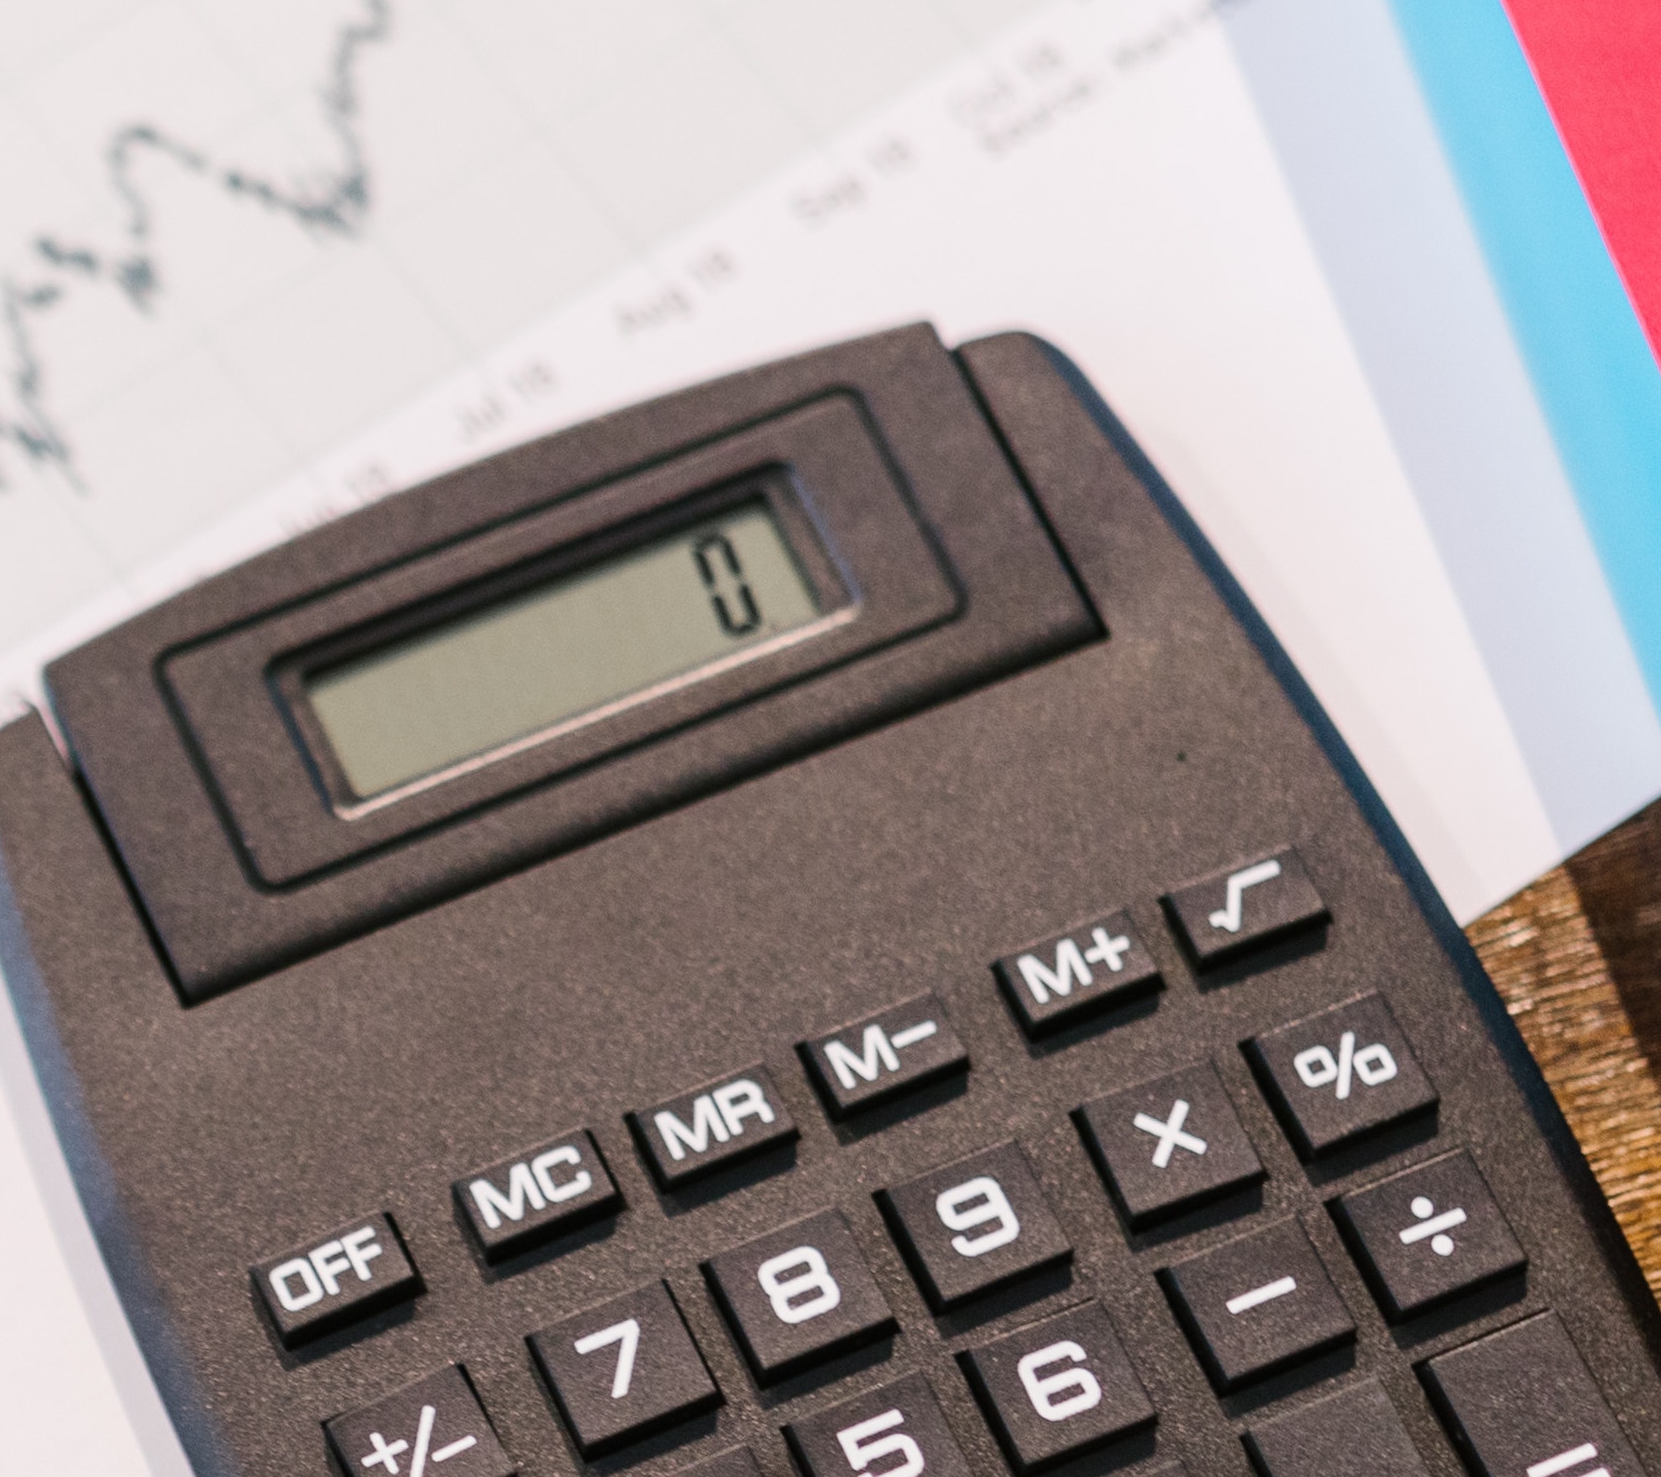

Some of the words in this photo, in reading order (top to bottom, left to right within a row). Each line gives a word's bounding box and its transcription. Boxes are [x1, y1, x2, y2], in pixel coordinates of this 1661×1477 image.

[691, 529, 762, 637] 0
[1019, 929, 1129, 1002] M+
[1295, 1033, 1396, 1098] %
[655, 1081, 773, 1159] MR
[471, 1147, 591, 1228] MC
[937, 1178, 1019, 1255] 9
[270, 1227, 381, 1311] OFF
[759, 1247, 839, 1322] 8
[575, 1319, 639, 1398] 7
[1019, 1341, 1100, 1420] 6
